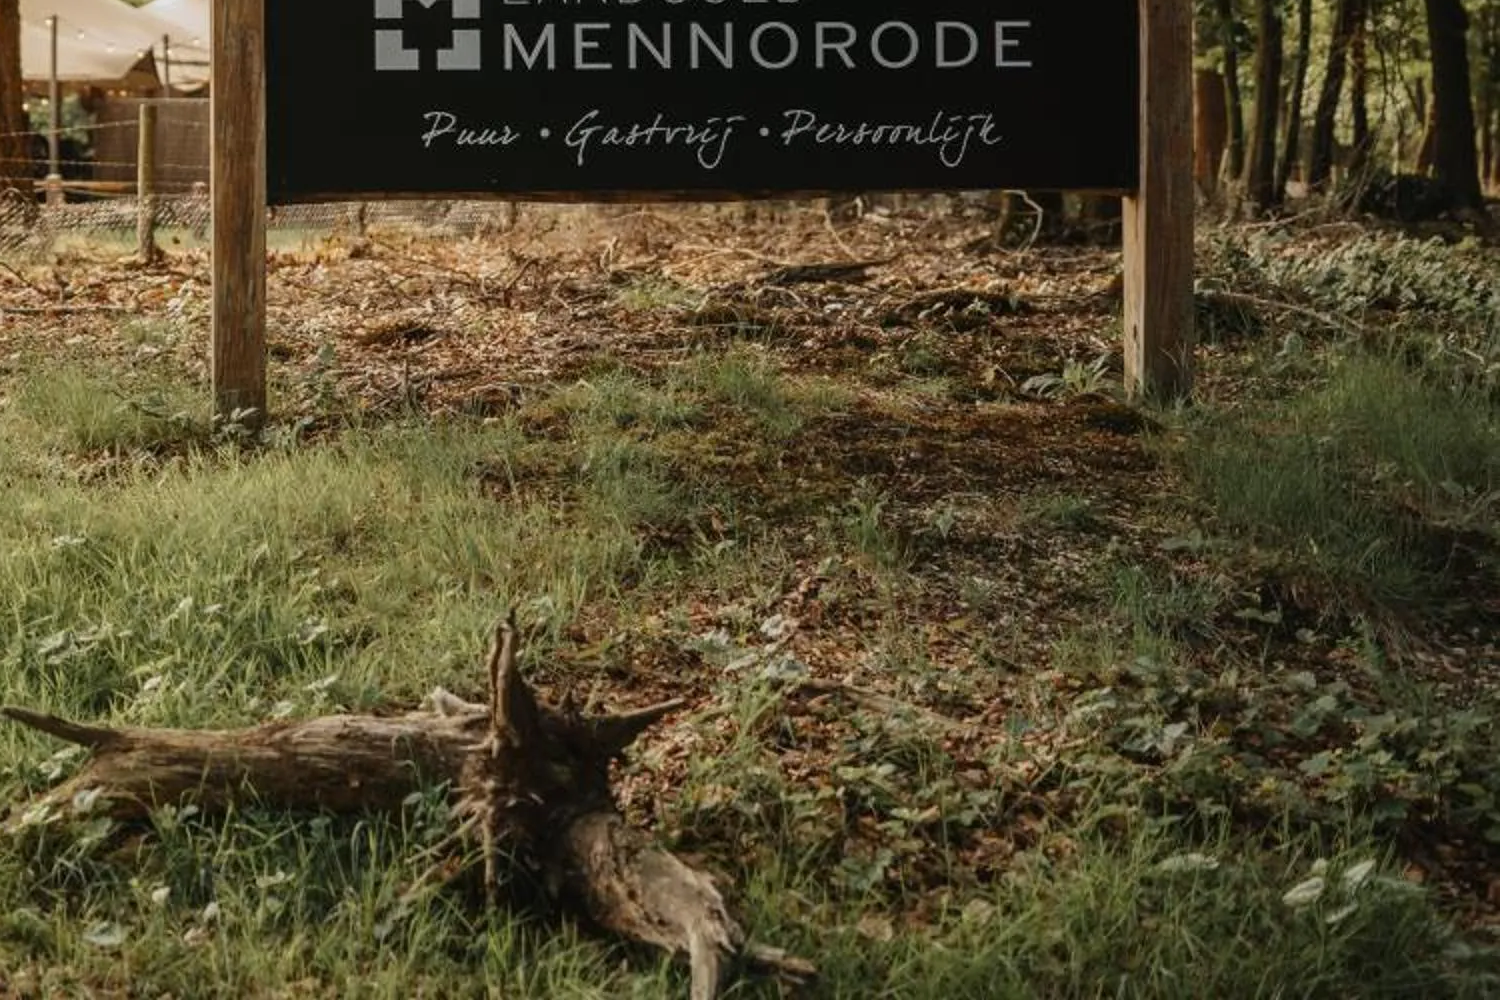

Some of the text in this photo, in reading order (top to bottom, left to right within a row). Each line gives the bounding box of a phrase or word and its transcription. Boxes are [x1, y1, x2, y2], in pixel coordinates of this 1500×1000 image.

[503, 20, 1032, 71] MENNORODE
[421, 109, 1001, 169] Puur Gastvrij Persoonlijk
